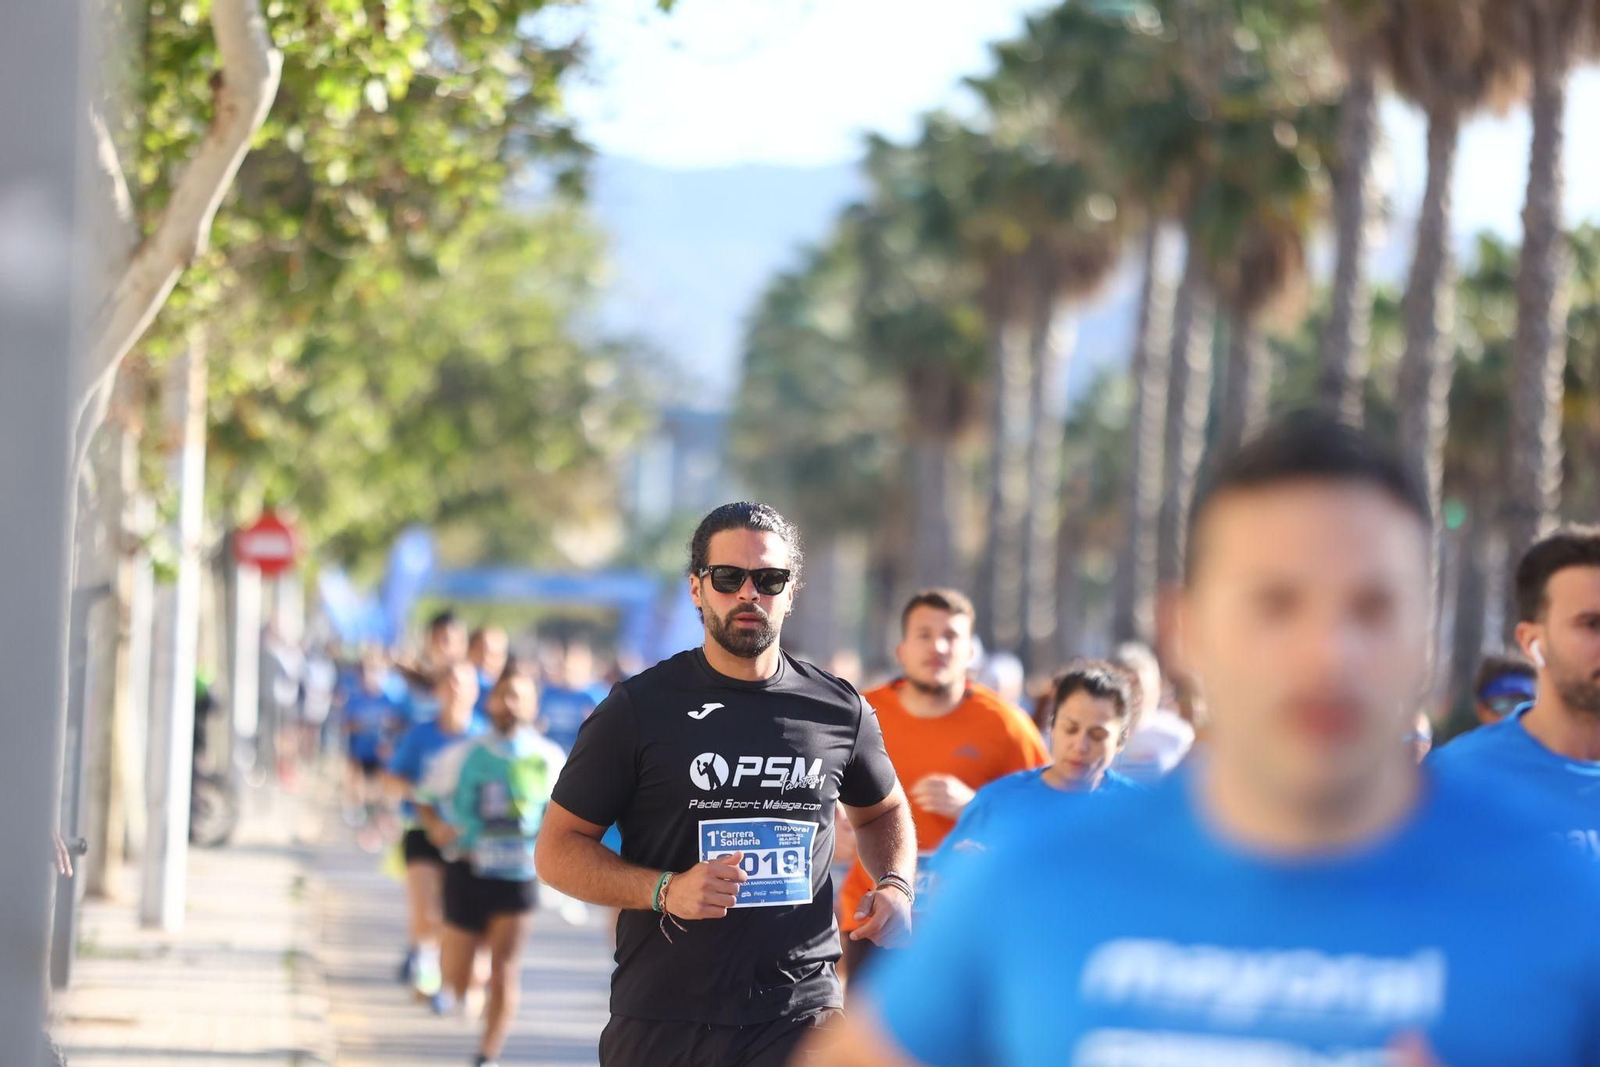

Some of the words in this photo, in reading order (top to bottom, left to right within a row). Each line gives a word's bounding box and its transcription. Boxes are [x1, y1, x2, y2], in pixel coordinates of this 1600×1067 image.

[732, 756, 823, 788] PSM
[688, 799, 723, 809] Pádel
[723, 798, 762, 810] Sport
[762, 799, 822, 812] Málaga.com
[720, 830, 754, 839] Carrera
[774, 825, 810, 833] mayoral
[720, 837, 761, 847] Solidaria
[717, 850, 799, 877] 019
